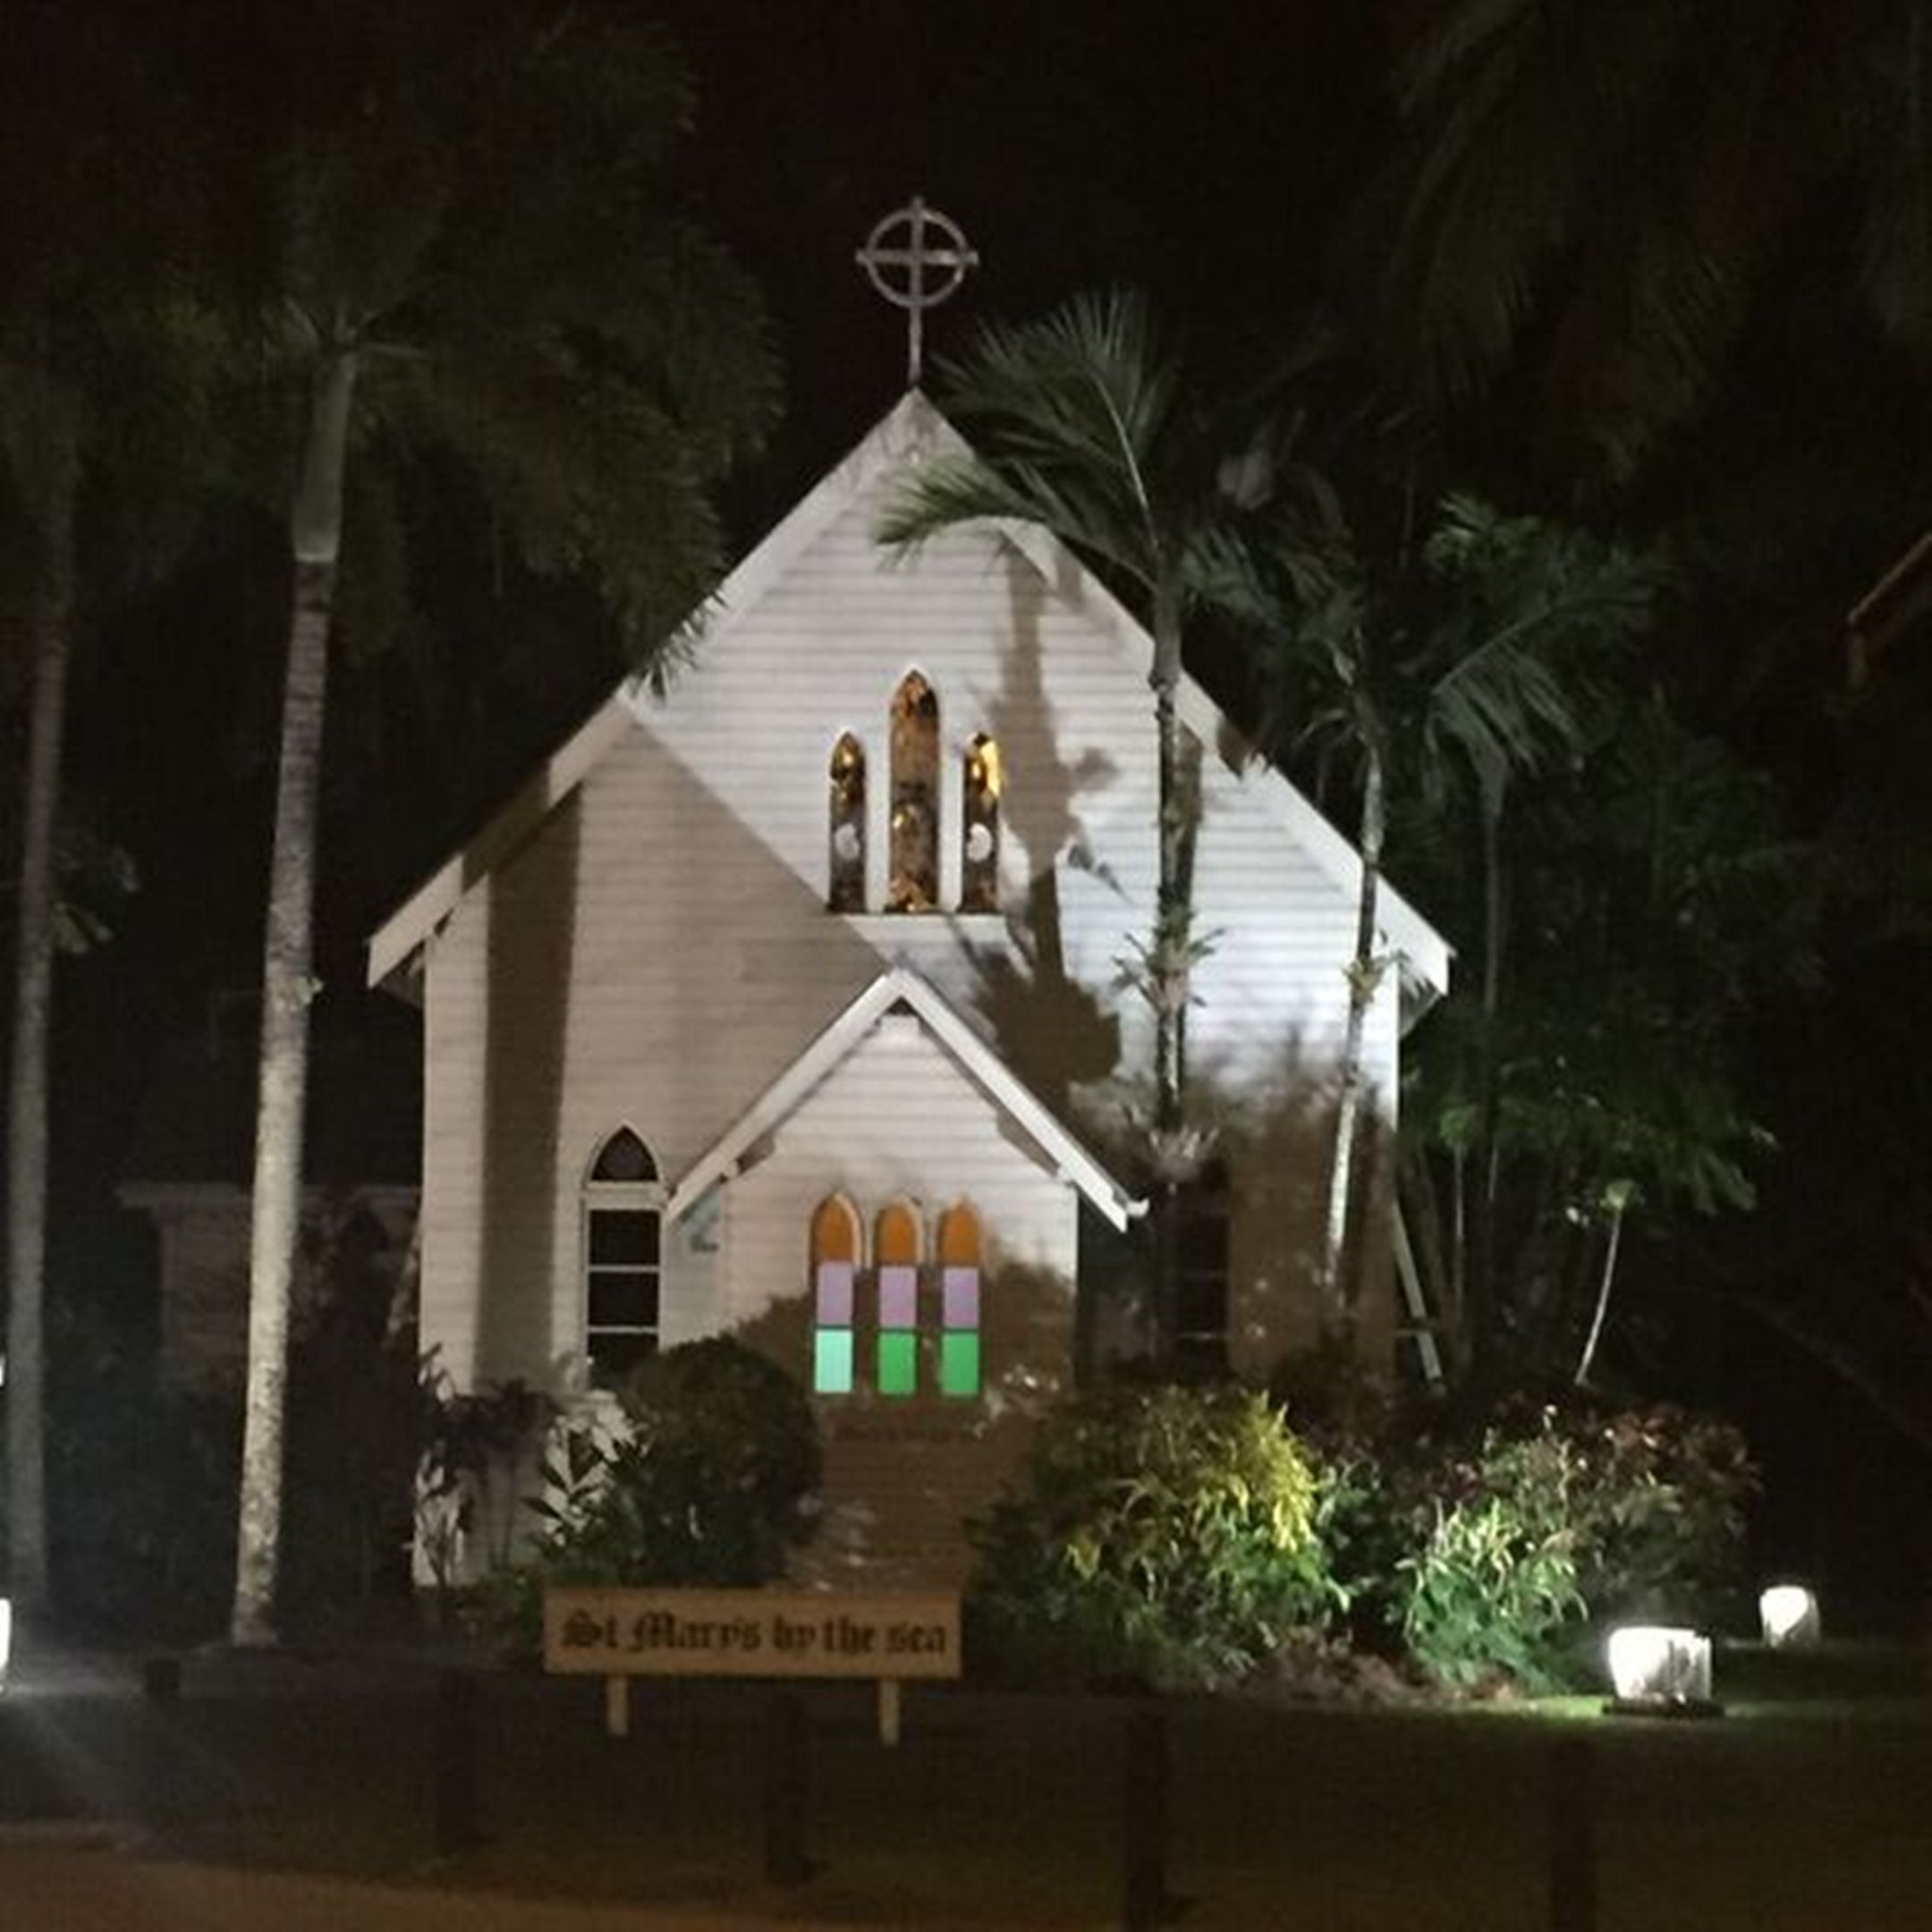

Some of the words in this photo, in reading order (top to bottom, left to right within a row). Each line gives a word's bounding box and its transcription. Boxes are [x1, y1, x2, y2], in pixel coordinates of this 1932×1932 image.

[562, 1610, 619, 1648] St
[773, 1614, 817, 1651] by
[823, 1615, 876, 1653] the
[884, 1622, 946, 1653] sea
